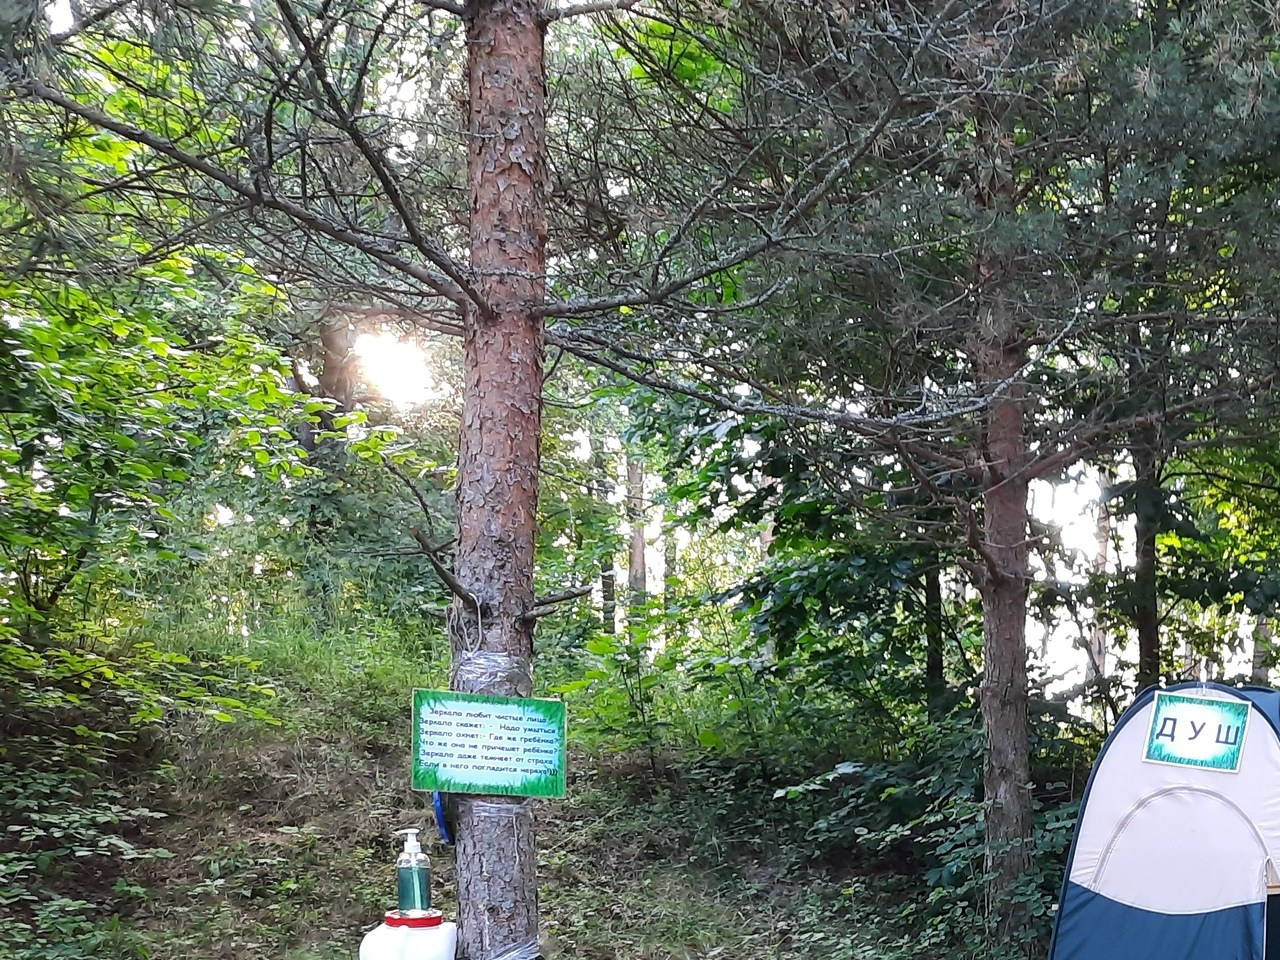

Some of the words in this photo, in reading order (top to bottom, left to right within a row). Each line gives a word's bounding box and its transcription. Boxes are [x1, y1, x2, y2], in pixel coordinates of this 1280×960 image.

[429, 707, 462, 717] Зеркало
[465, 711, 491, 719] любит
[419, 717, 452, 726] Зеркало
[499, 724, 520, 732] Надо
[419, 728, 453, 737] Зеркало
[489, 733, 504, 741] Где
[520, 736, 559, 744] гребёнка?
[419, 738, 434, 746] Что
[481, 744, 520, 752] причешет
[523, 746, 558, 754] ребёнка?
[420, 749, 454, 758] Зеркало
[419, 759, 440, 768] Если
[472, 764, 517, 773] поглядится
